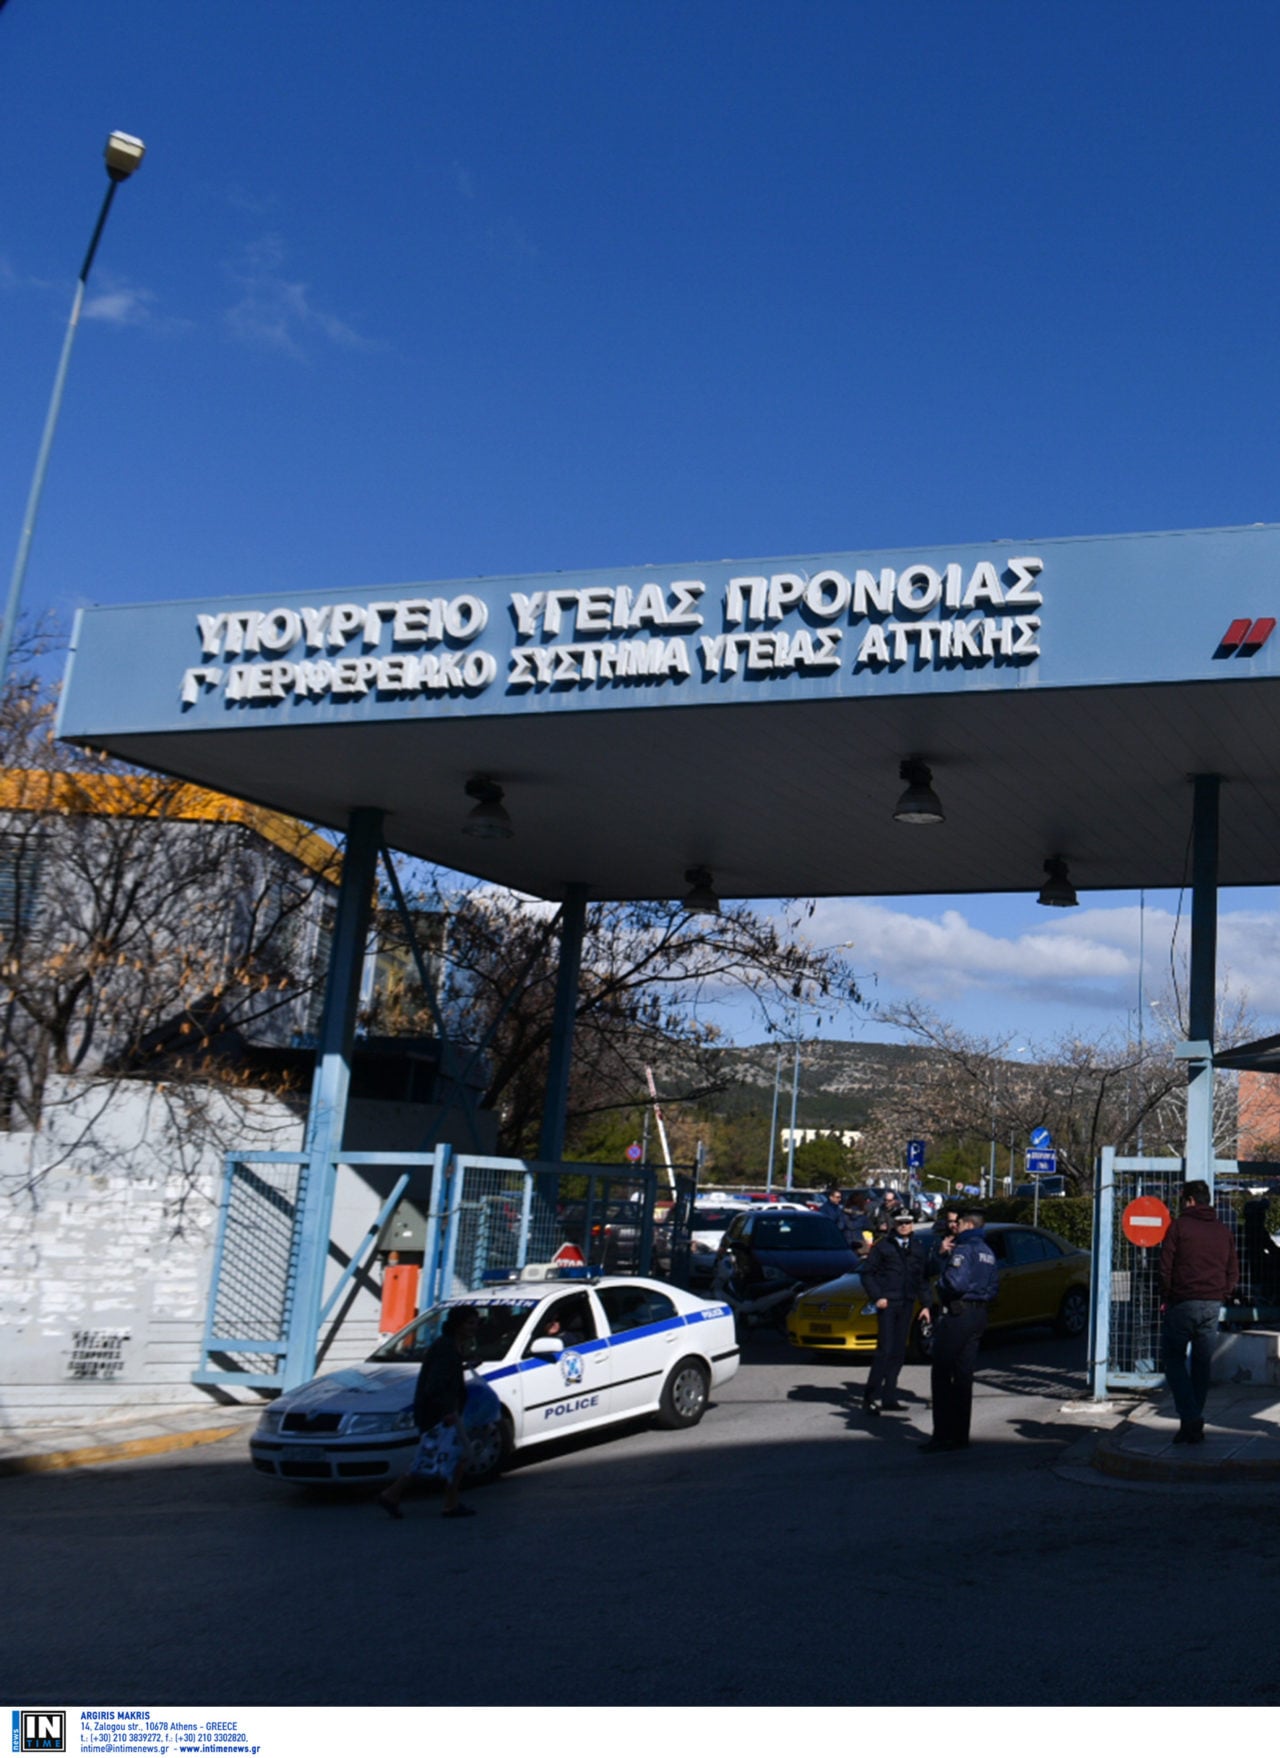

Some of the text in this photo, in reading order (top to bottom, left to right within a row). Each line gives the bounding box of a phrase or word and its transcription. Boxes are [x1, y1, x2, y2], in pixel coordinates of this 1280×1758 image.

[197, 556, 1044, 656] ΥΠΟΥΡΓΕΙΟ ΥΓΕΙΑΣ ΠΡΟΝΟΙΑΣ
[225, 650, 497, 701] ΠΕΡΙΦΕΡΕΙΑΚΟ
[508, 637, 691, 685] ΣΥΣΤΗΜΑ
[701, 627, 843, 675] ΥΓΕΙΑΣ
[857, 615, 1042, 664] ΑΤΤΙΚΗΣ
[544, 1395, 599, 1419] POLICE
